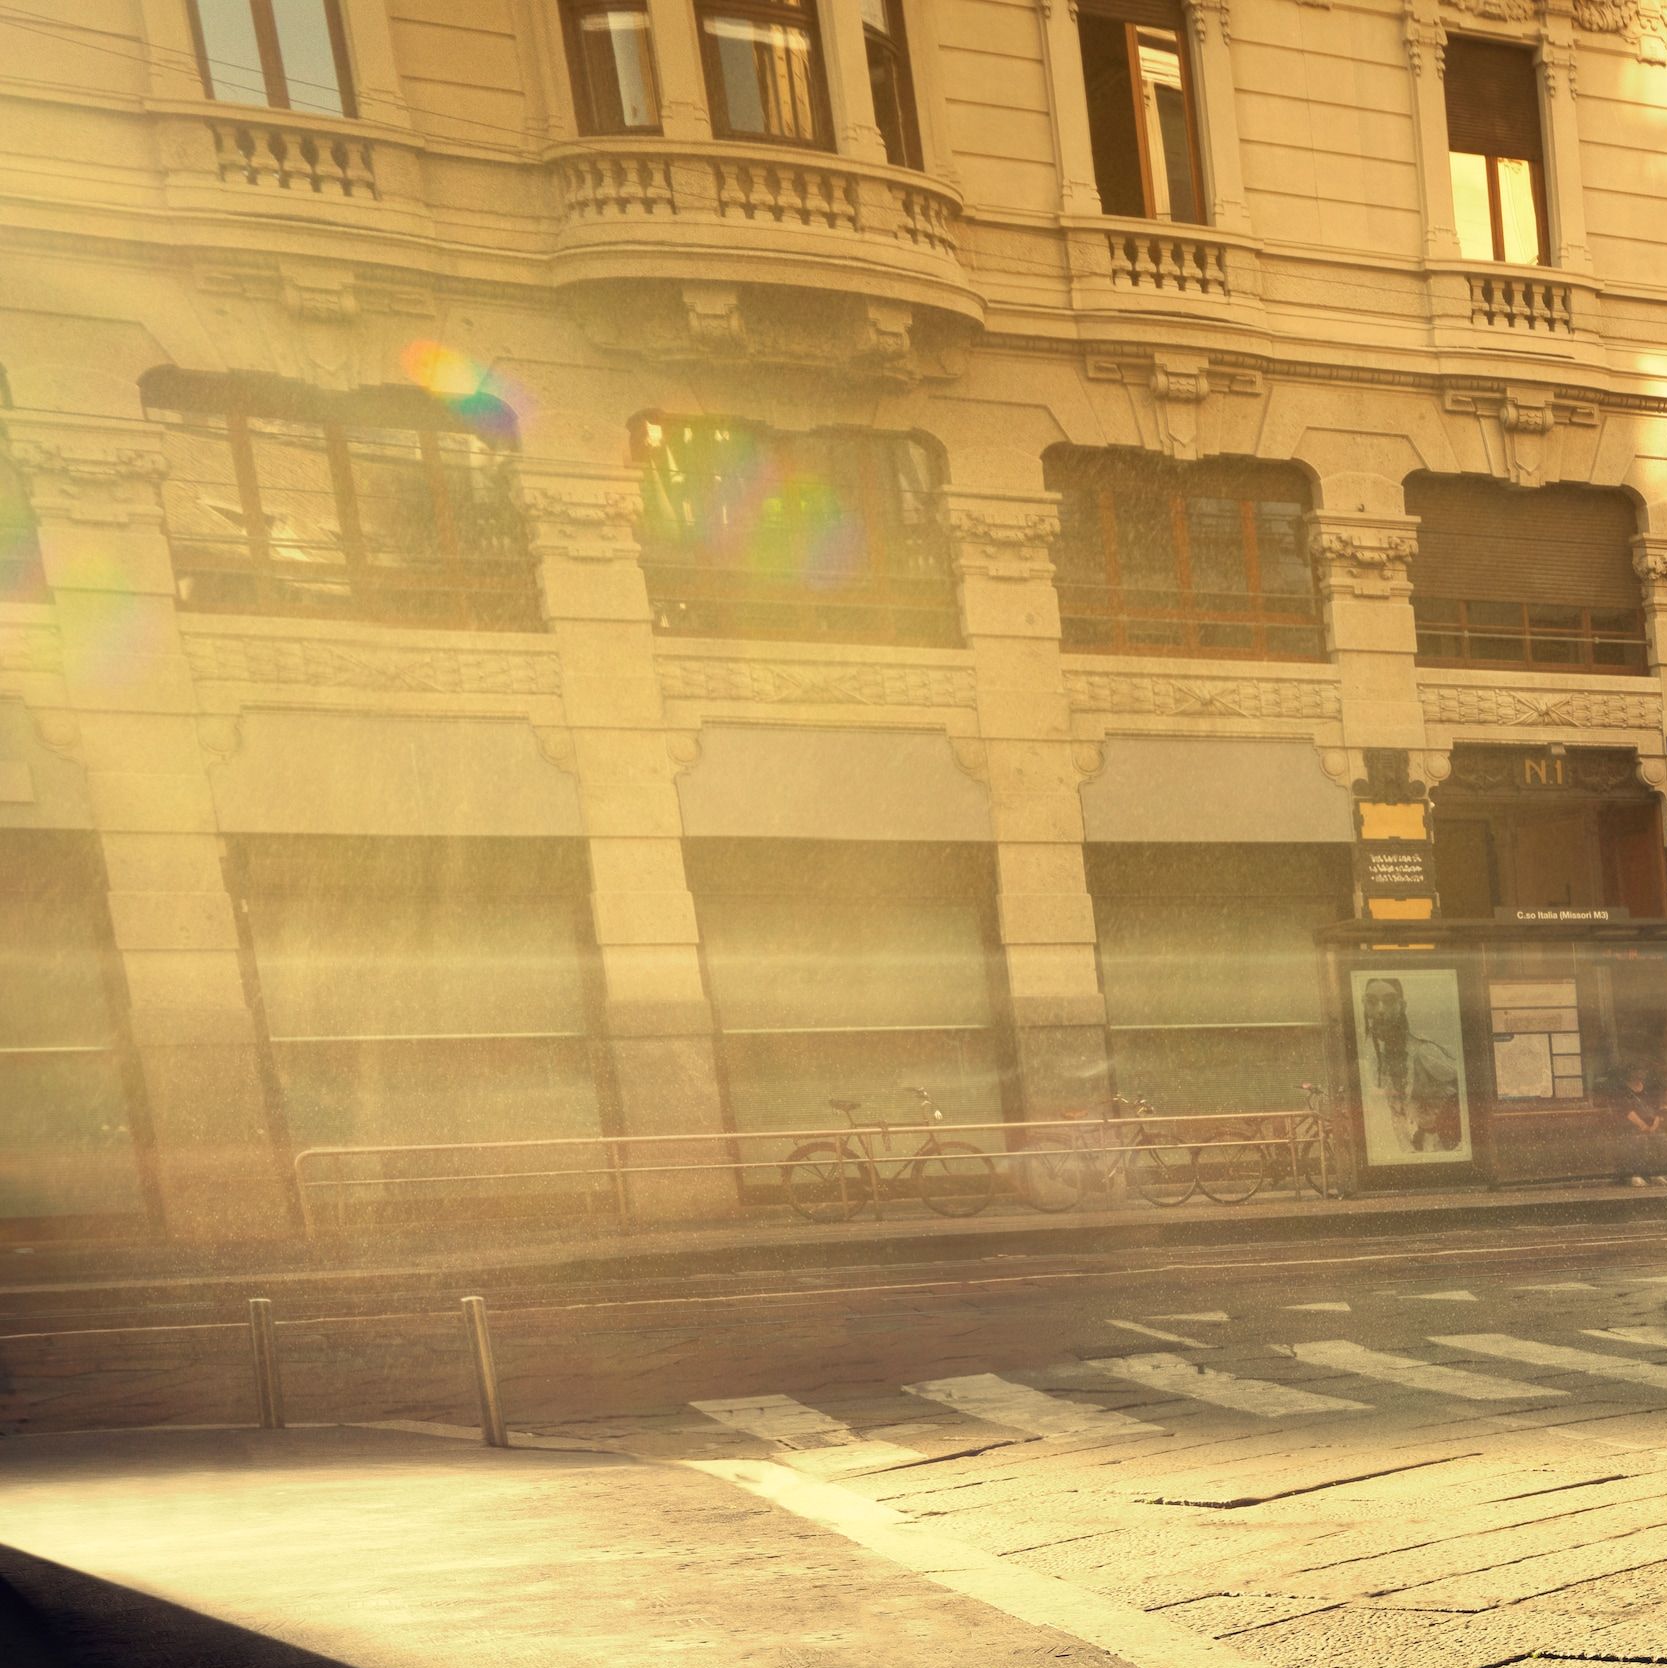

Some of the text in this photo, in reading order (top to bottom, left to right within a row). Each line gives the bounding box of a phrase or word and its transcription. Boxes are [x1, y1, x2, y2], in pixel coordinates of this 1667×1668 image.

[1524, 759, 1564, 785] N.1
[1517, 911, 1609, 920] C.so Italia (Missori M3)
